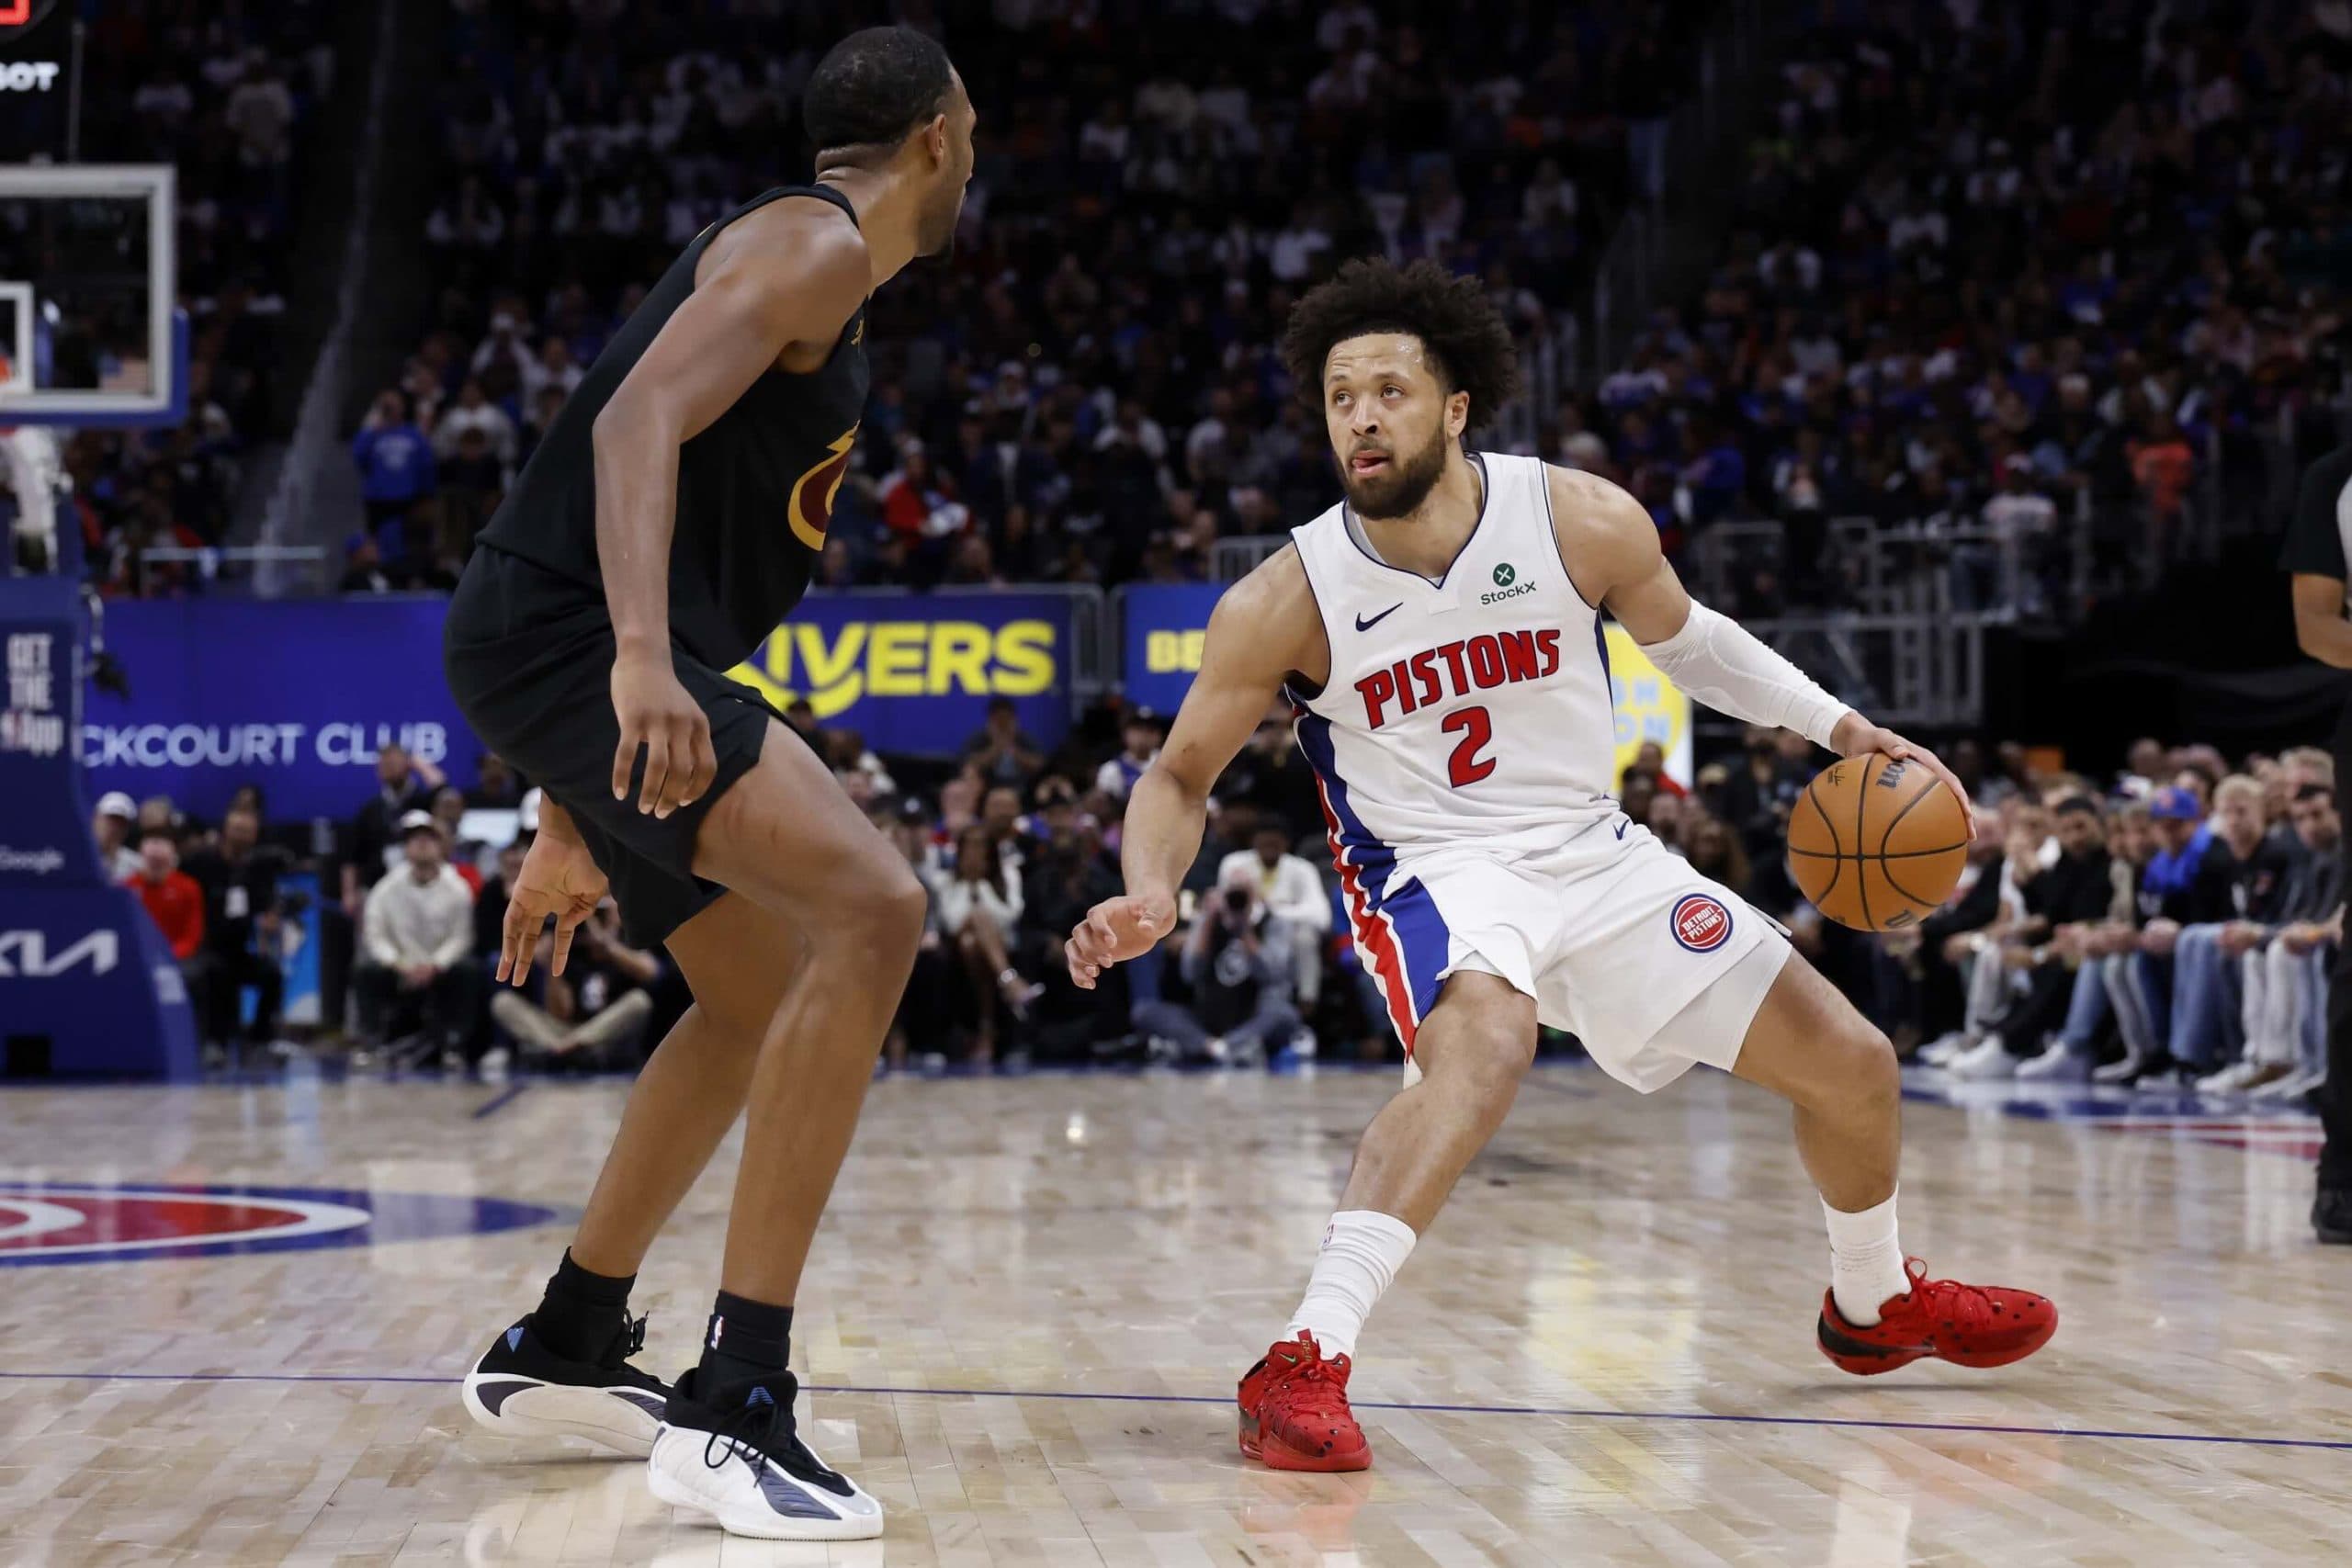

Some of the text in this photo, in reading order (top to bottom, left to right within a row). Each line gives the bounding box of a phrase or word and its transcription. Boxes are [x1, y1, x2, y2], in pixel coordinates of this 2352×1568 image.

[1480, 581, 1537, 605] StockX
[1354, 628, 1561, 730] PISTONS
[316, 720, 448, 766] CLUB
[1441, 705, 1497, 789] 2
[1681, 906, 1714, 931] DETROIT
[1688, 913, 1722, 940] PISTONS
